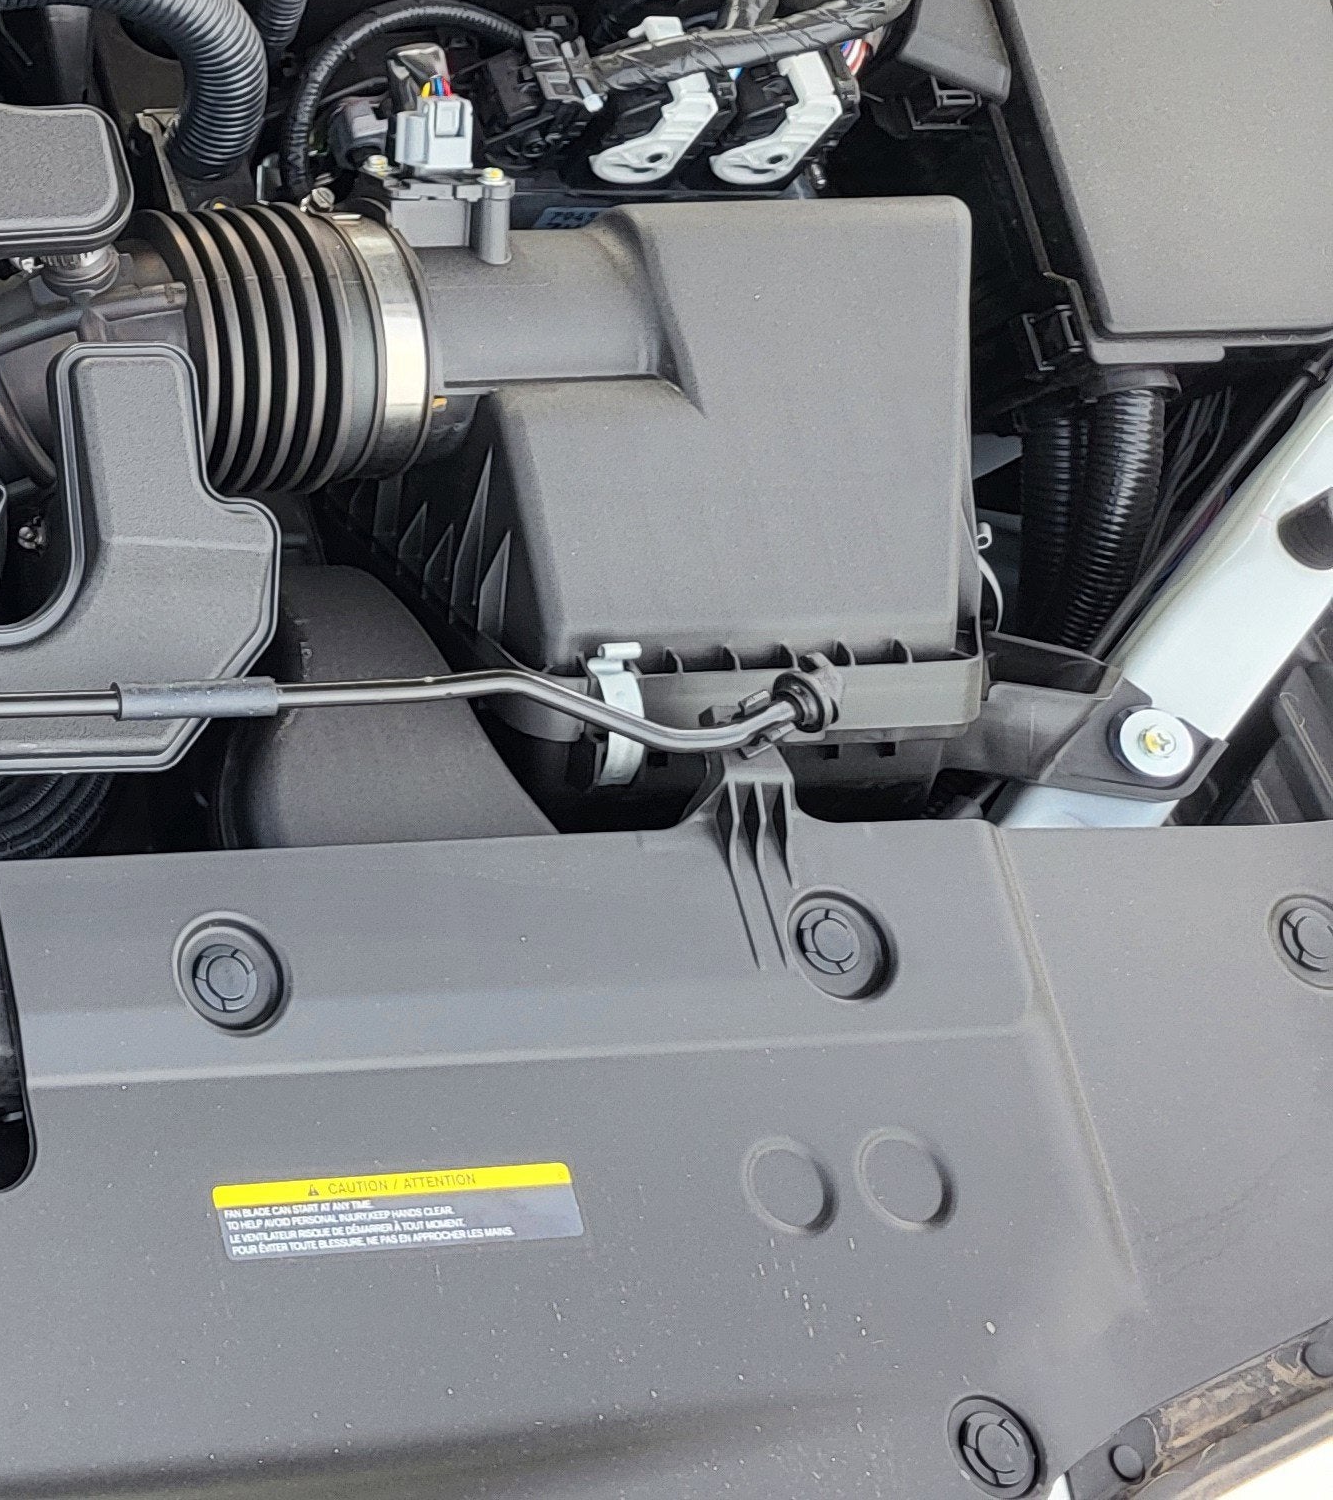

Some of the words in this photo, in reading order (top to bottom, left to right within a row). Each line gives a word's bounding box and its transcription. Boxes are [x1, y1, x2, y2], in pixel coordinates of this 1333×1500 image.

[328, 1180, 388, 1194] CAUTION
[404, 1173, 476, 1189] ATTENTION
[224, 1208, 241, 1219] FAN
[242, 1207, 269, 1218] BLADE
[270, 1205, 292, 1216] CAN
[292, 1203, 318, 1214] START
[321, 1202, 332, 1212] AT
[333, 1201, 350, 1211] ANY
[350, 1199, 372, 1209] TIME.
[226, 1220, 240, 1230] TO
[240, 1219, 263, 1230] HELP
[264, 1217, 291, 1228] AVOID
[292, 1214, 338, 1226] PERSONAL
[392, 1208, 422, 1219] HANDS
[423, 1205, 455, 1216] CLEAR.
[229, 1234, 241, 1244] LE
[242, 1230, 297, 1243] VENTILATEUR
[298, 1227, 331, 1239] RISQUE
[333, 1226, 345, 1236] DE
[346, 1222, 393, 1235] DÉMARRER
[402, 1220, 424, 1231] TOUT
[425, 1218, 467, 1229] MOMENT.
[232, 1245, 258, 1256] POUR
[258, 1242, 288, 1254] ÉVITER
[288, 1240, 318, 1252] TOUTE
[366, 1235, 380, 1245] NE
[380, 1234, 398, 1244] PAS
[399, 1233, 411, 1243] EN
[413, 1229, 467, 1242] APPROCHER
[467, 1228, 484, 1238] LES
[484, 1226, 515, 1237] MAINS.
